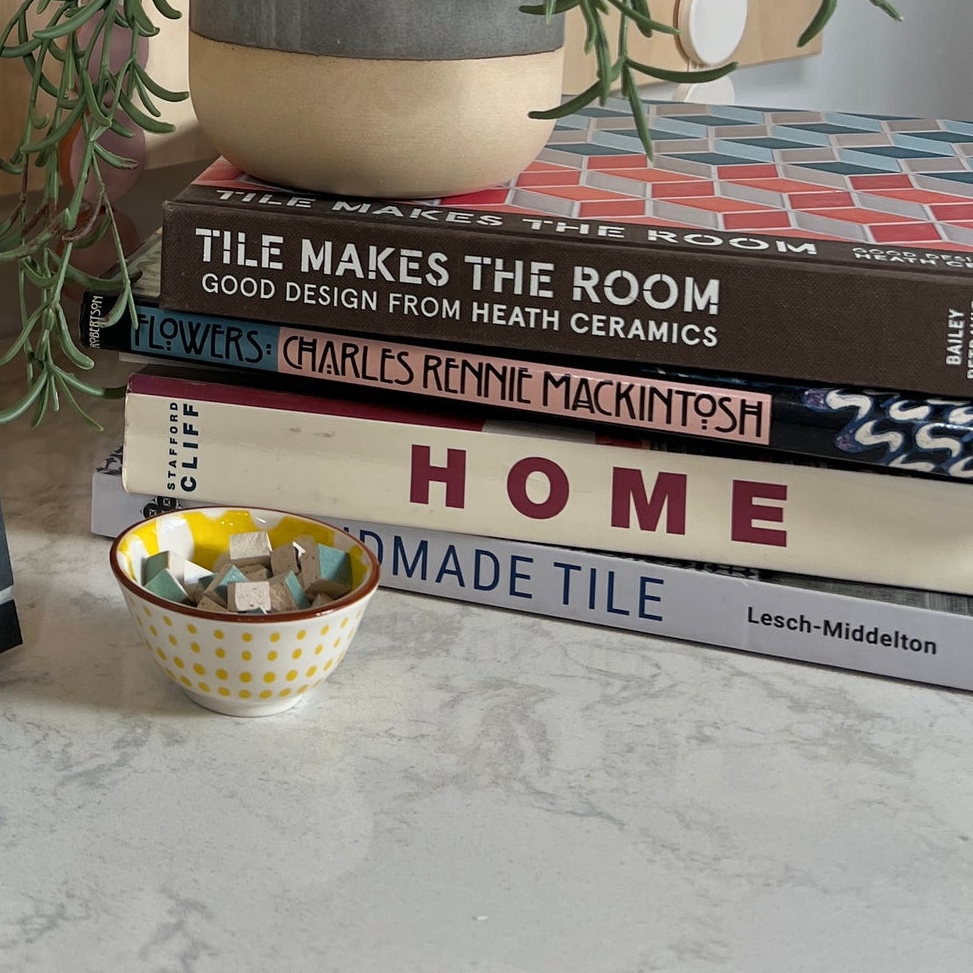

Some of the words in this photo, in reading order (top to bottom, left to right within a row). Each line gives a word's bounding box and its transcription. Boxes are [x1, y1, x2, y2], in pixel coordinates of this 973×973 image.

[215, 189, 317, 209] TILE
[332, 201, 503, 227] MAKES
[522, 218, 625, 238] THE
[647, 229, 818, 256] ROOM
[851, 247, 917, 258] GOOD
[854, 252, 938, 267] HEATH
[194, 228, 285, 270] TILE
[300, 238, 449, 287] MAKES
[464, 255, 554, 298] THE
[572, 266, 720, 315] ROOM
[89, 295, 104, 349] ROBERTSON
[201, 273, 276, 300] GOOD
[285, 281, 378, 312] DESIGN
[389, 293, 461, 321] FROM
[472, 302, 560, 331] HEATH
[570, 312, 719, 347] CERAMICS
[945, 308, 965, 366] BAILEY
[282, 335, 414, 386] CHARLES
[423, 353, 532, 405] RENNIE
[542, 370, 763, 438] MACKINTOSH
[167, 402, 178, 491] STAFFORD
[180, 403, 200, 492] CLIFF
[409, 443, 788, 547] HOME
[343, 526, 534, 600] DMADE
[553, 561, 665, 622] TILE
[747, 606, 938, 656] Lesch-Middelton
